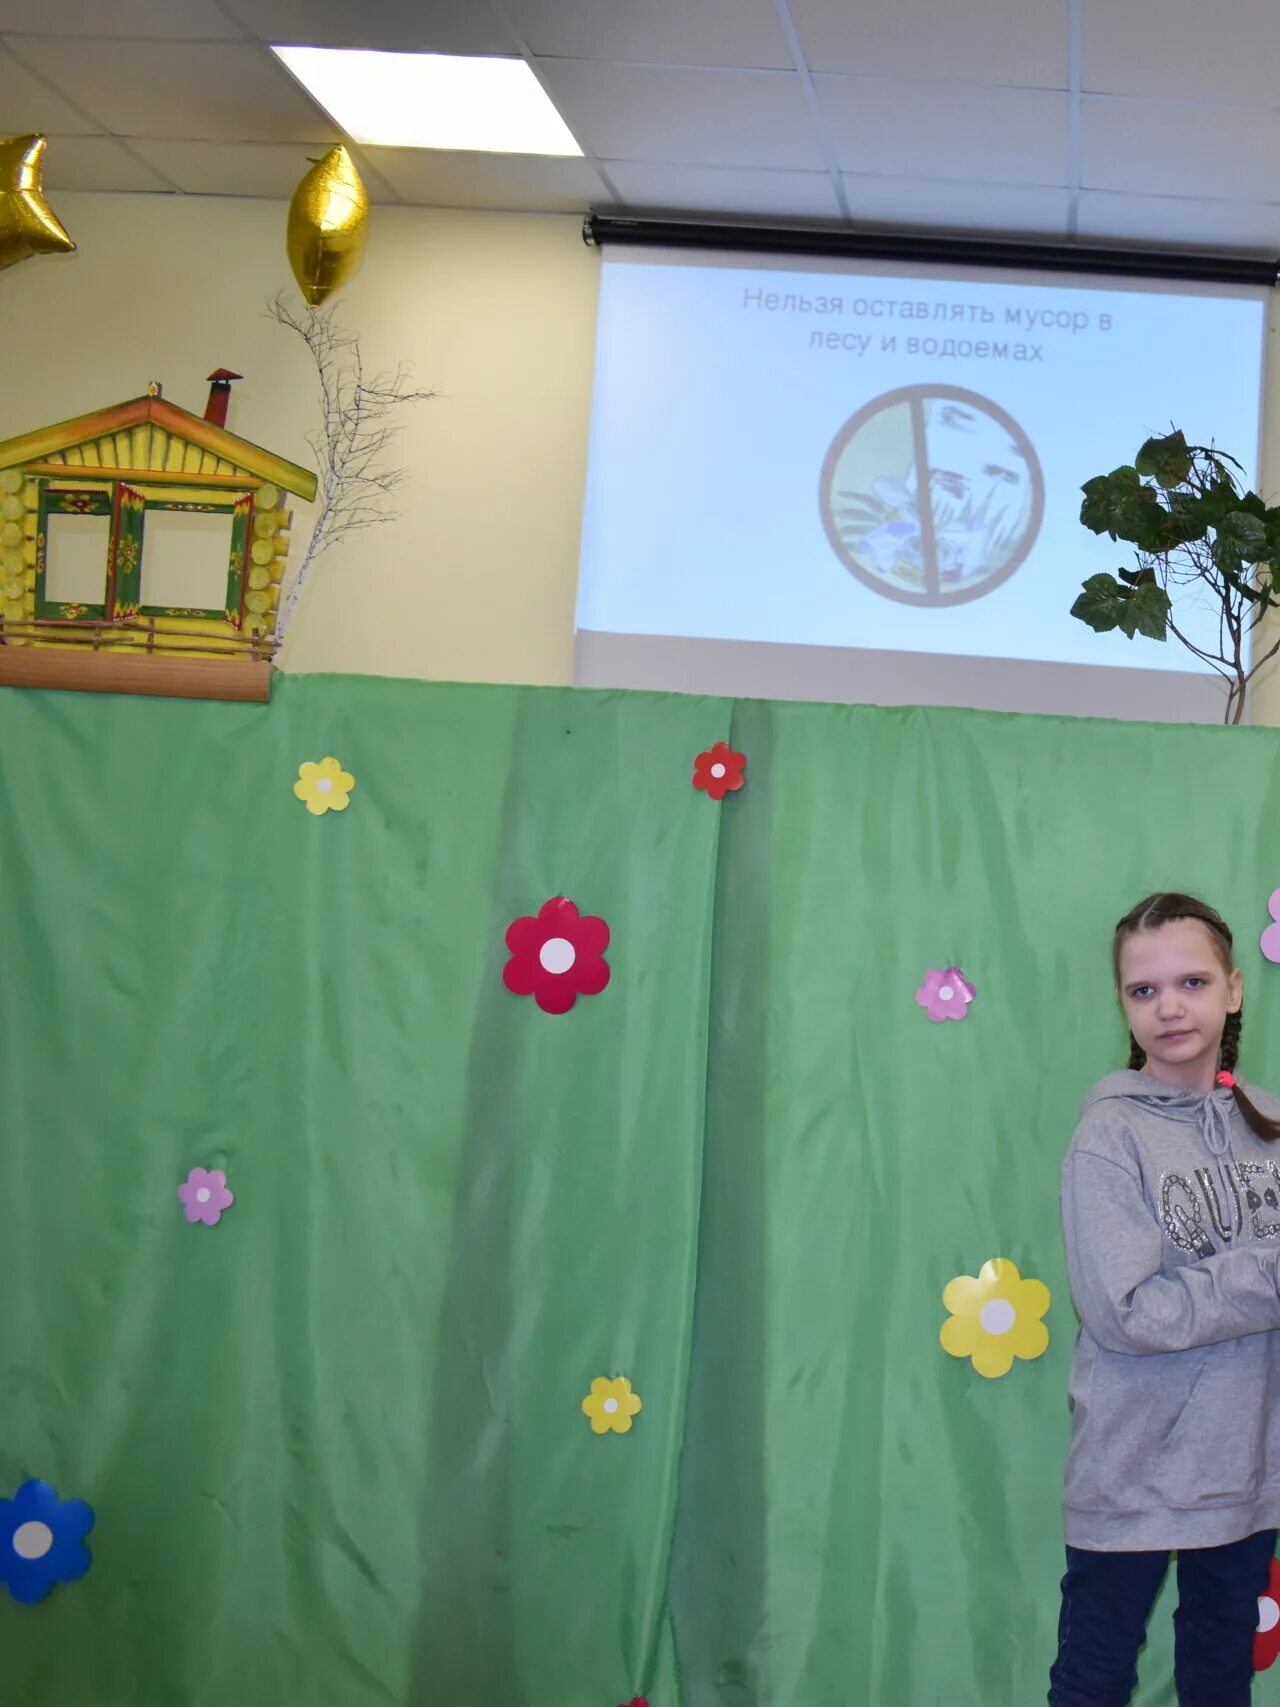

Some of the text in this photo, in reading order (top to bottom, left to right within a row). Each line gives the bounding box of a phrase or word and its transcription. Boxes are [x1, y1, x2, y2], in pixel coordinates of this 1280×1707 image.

[743, 287, 1113, 335] Нельзя оставлять мусор в
[809, 330, 1043, 362] лесу и водоемах
